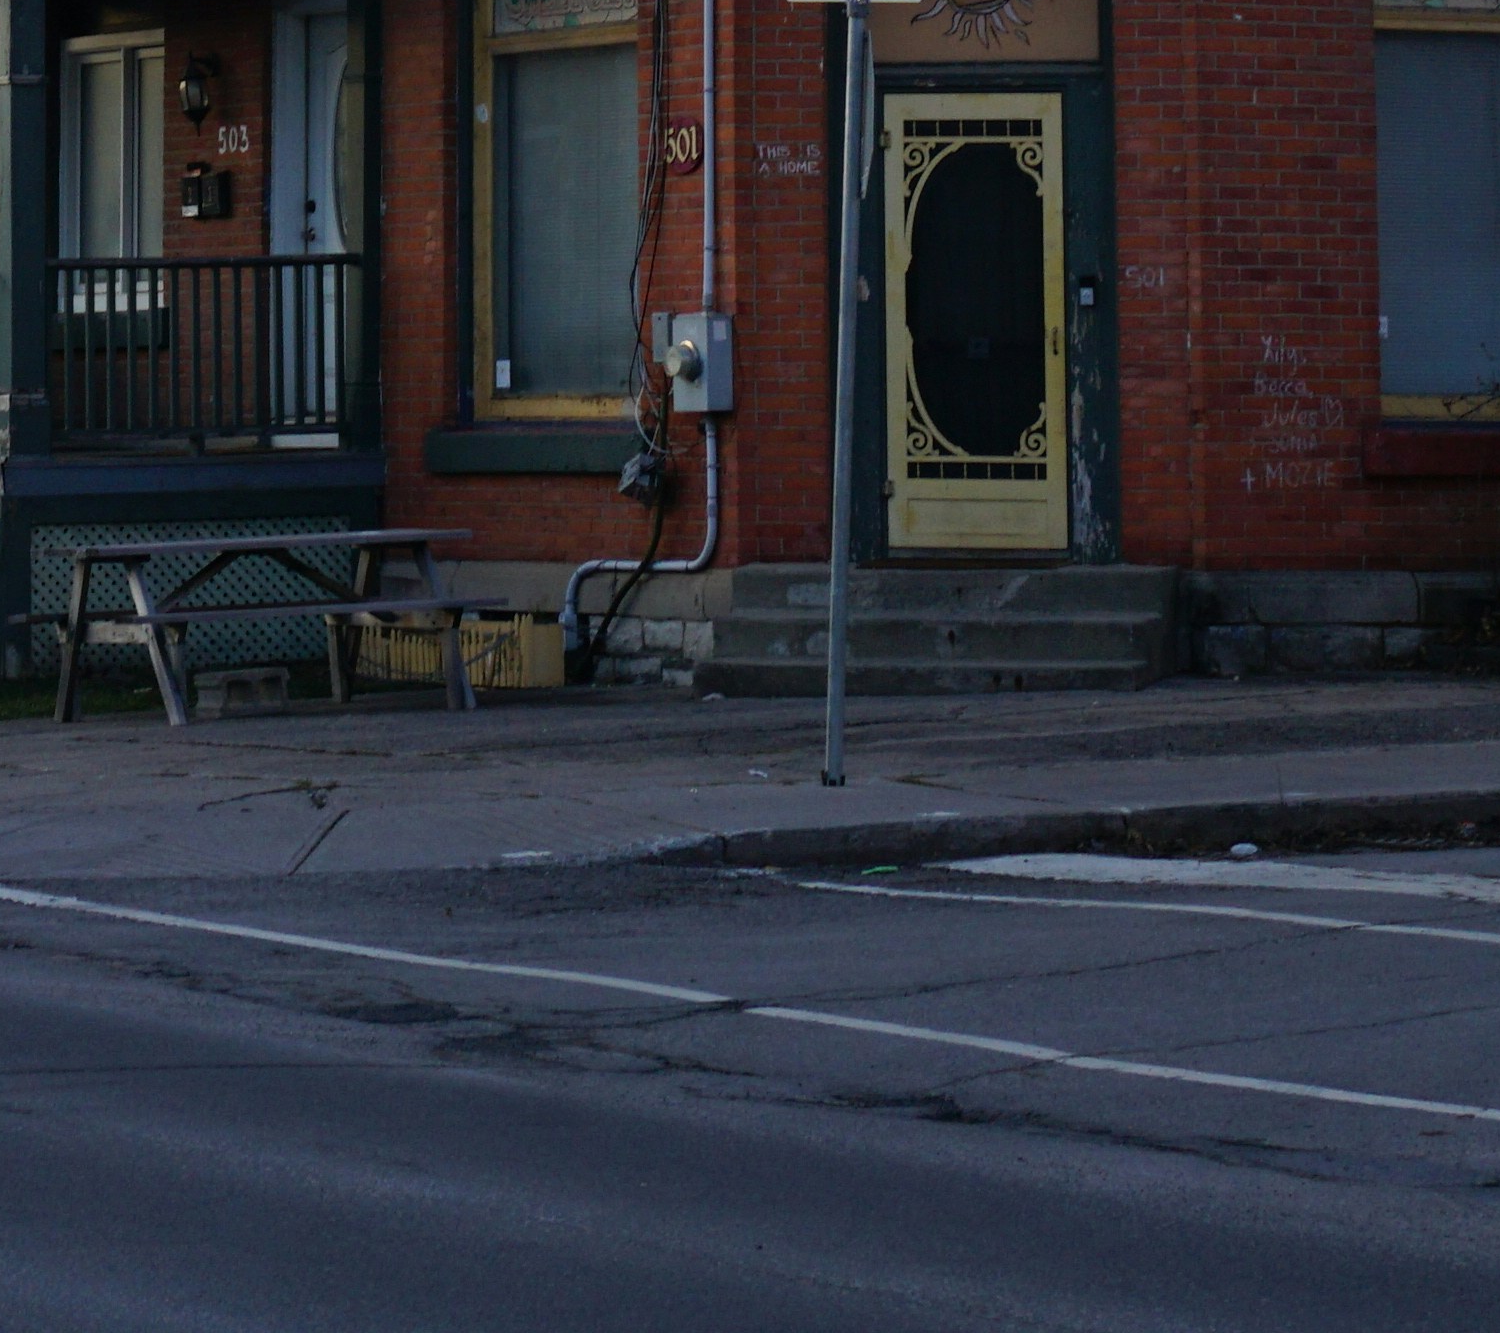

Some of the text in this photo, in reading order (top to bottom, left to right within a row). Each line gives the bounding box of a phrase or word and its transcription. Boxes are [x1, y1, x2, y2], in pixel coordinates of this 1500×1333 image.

[218, 124, 249, 154] 503
[664, 124, 700, 164] 501
[756, 143, 821, 159] THIS IS
[779, 161, 821, 175] HOME
[1125, 266, 1165, 288] 501
